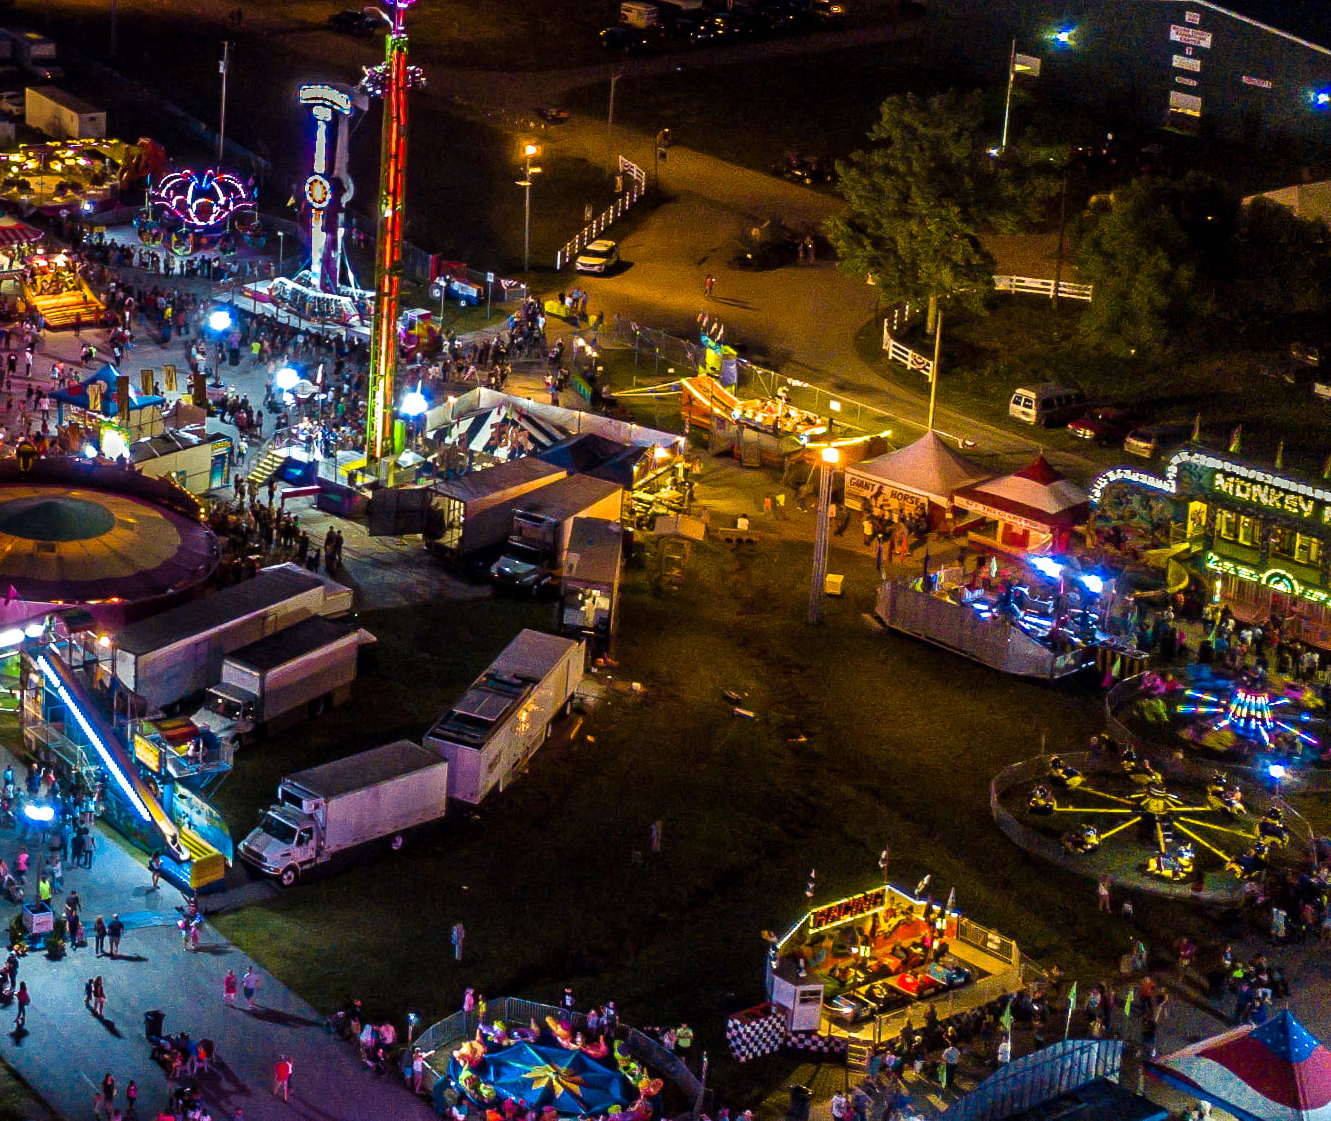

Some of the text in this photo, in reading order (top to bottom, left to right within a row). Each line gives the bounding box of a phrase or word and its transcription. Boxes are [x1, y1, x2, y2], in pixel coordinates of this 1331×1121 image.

[849, 477, 920, 506] GIANT HORSE
[1214, 473, 1314, 517] MONKEY
